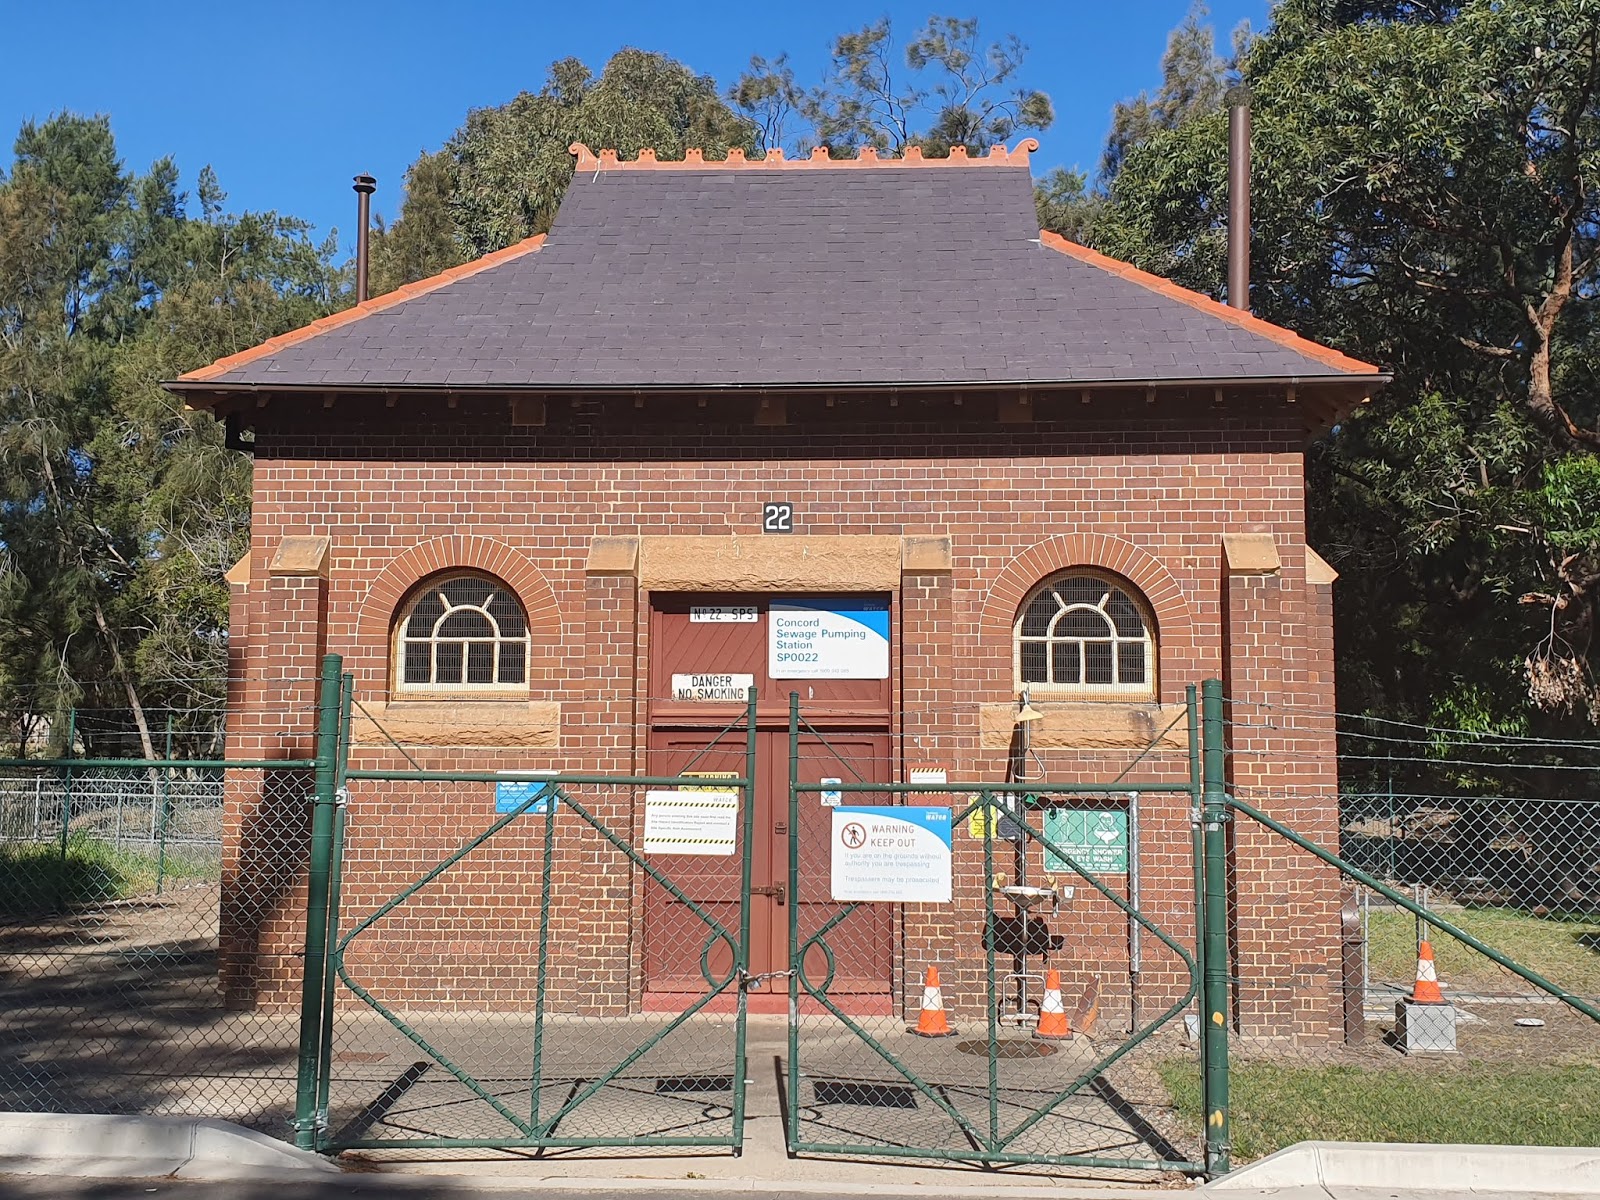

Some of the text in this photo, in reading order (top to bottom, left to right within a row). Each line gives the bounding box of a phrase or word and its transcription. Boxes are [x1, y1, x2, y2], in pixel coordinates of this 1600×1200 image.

[766, 505, 790, 530] 22
[710, 608, 722, 620] 22
[732, 608, 753, 620] SPS
[776, 618, 820, 628] Concord
[776, 629, 866, 640] Sewage Pumping
[776, 640, 813, 650] Station
[776, 652, 818, 662] SP0022
[692, 676, 732, 688] DANGER
[678, 688, 744, 700] NO SMOKING
[872, 825, 914, 834] WARNING
[870, 838, 916, 847] KEEP OUT
